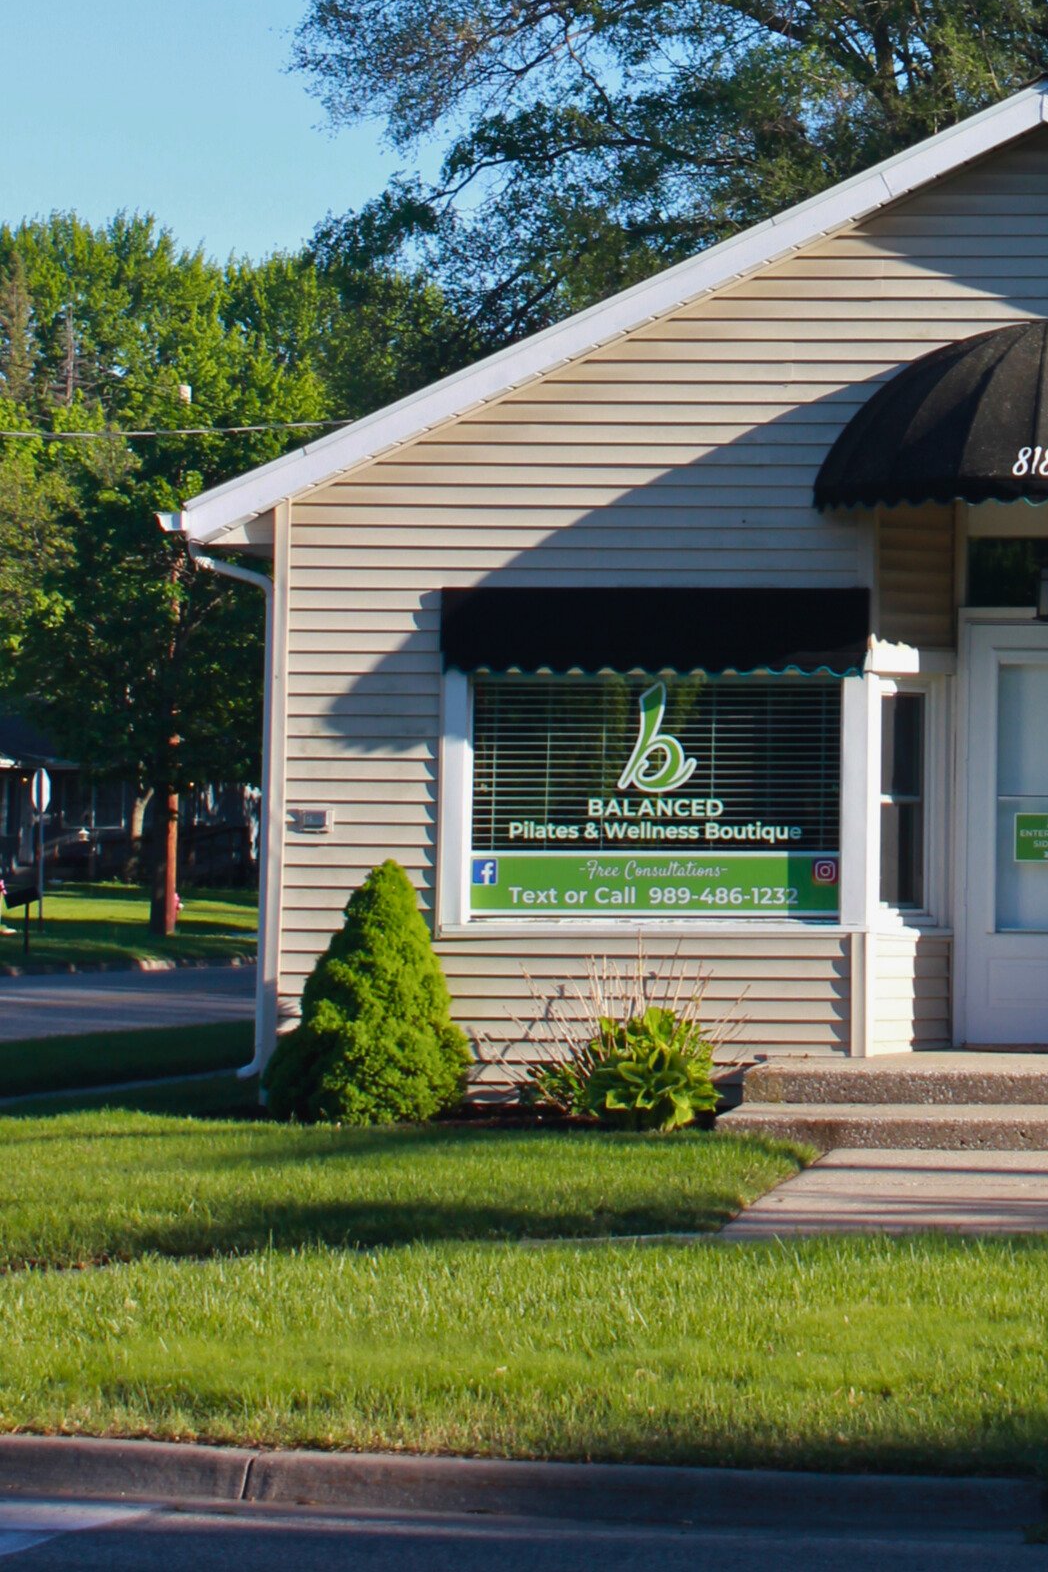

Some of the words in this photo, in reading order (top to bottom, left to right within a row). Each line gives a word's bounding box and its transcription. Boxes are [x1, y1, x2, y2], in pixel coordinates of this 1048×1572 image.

[588, 798, 723, 817] BALANCED
[508, 820, 579, 840] Pilates
[584, 822, 599, 840] &
[604, 820, 699, 840] Wellness
[705, 820, 802, 845] Boutique
[509, 886, 558, 905] Text
[565, 890, 588, 905] or
[593, 886, 636, 905] Call
[648, 886, 798, 905] 989-486-1232
